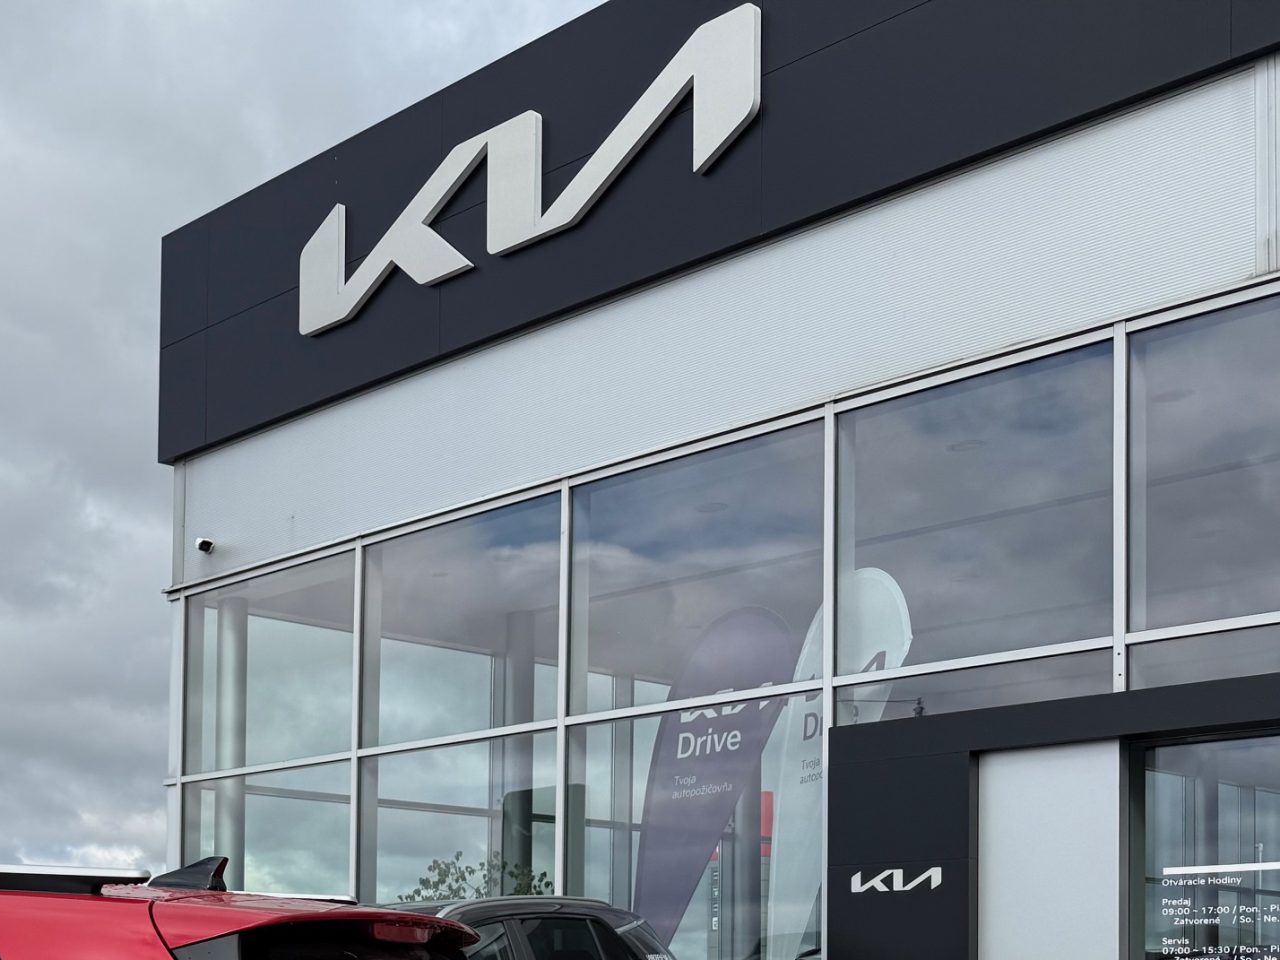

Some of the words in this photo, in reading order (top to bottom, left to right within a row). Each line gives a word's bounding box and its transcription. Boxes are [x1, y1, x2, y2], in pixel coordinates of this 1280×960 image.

[299, 3, 761, 336] KIA
[677, 728, 741, 759] Drive
[674, 776, 697, 787] Tvoja
[851, 867, 942, 893] KIA
[1162, 877, 1206, 887] Otváracie
[1208, 876, 1242, 886] Hodiny
[1162, 898, 1191, 907] Predaj
[1162, 907, 1190, 916] 09:00
[1202, 906, 1230, 915] 17:00
[1240, 905, 1261, 913] Pon.
[1174, 917, 1221, 925] Zatvorené
[1240, 915, 1254, 923] So.
[1263, 915, 1280, 923] Ne.
[1162, 947, 1191, 955] 07:00
[1202, 946, 1230, 954] 15:30
[1240, 945, 1261, 953] Pon.
